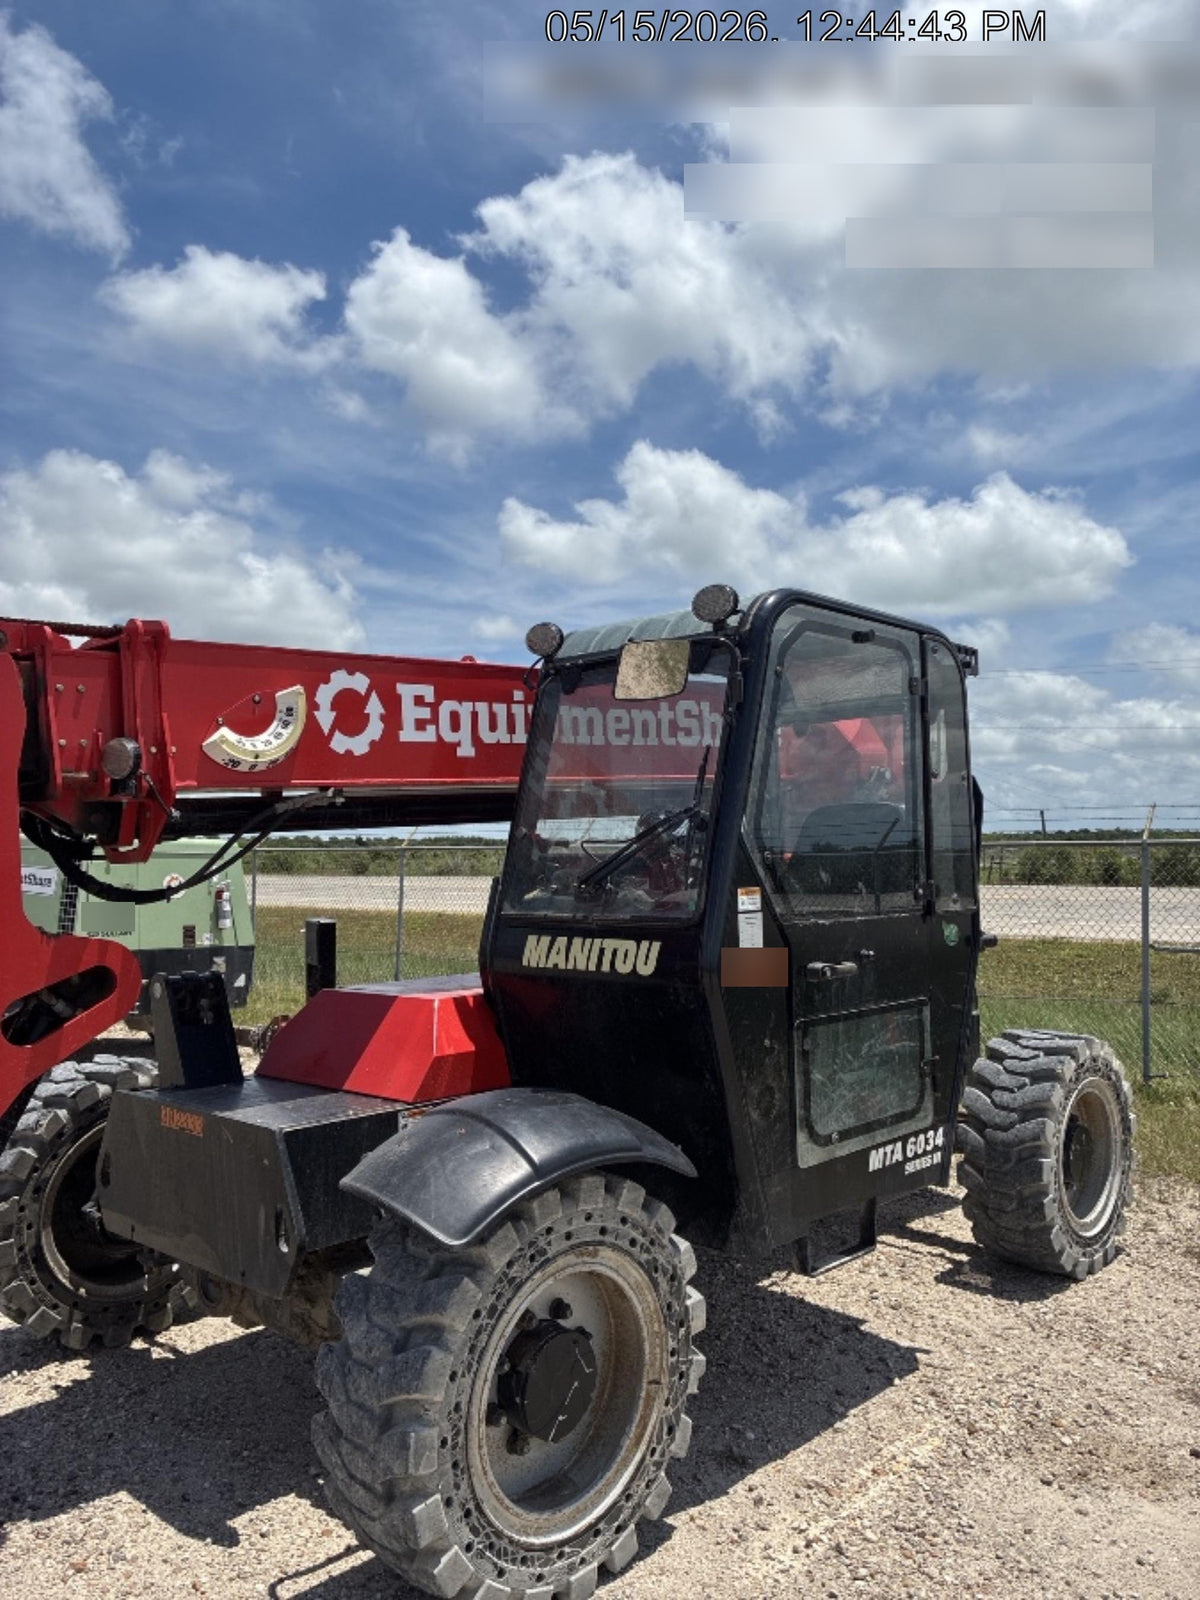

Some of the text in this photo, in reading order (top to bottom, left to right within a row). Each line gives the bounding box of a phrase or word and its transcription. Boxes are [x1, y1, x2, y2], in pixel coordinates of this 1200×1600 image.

[396, 682, 724, 757] EquimentSh
[522, 934, 662, 976] MANITOU
[868, 1126, 944, 1172] MTA 6034
